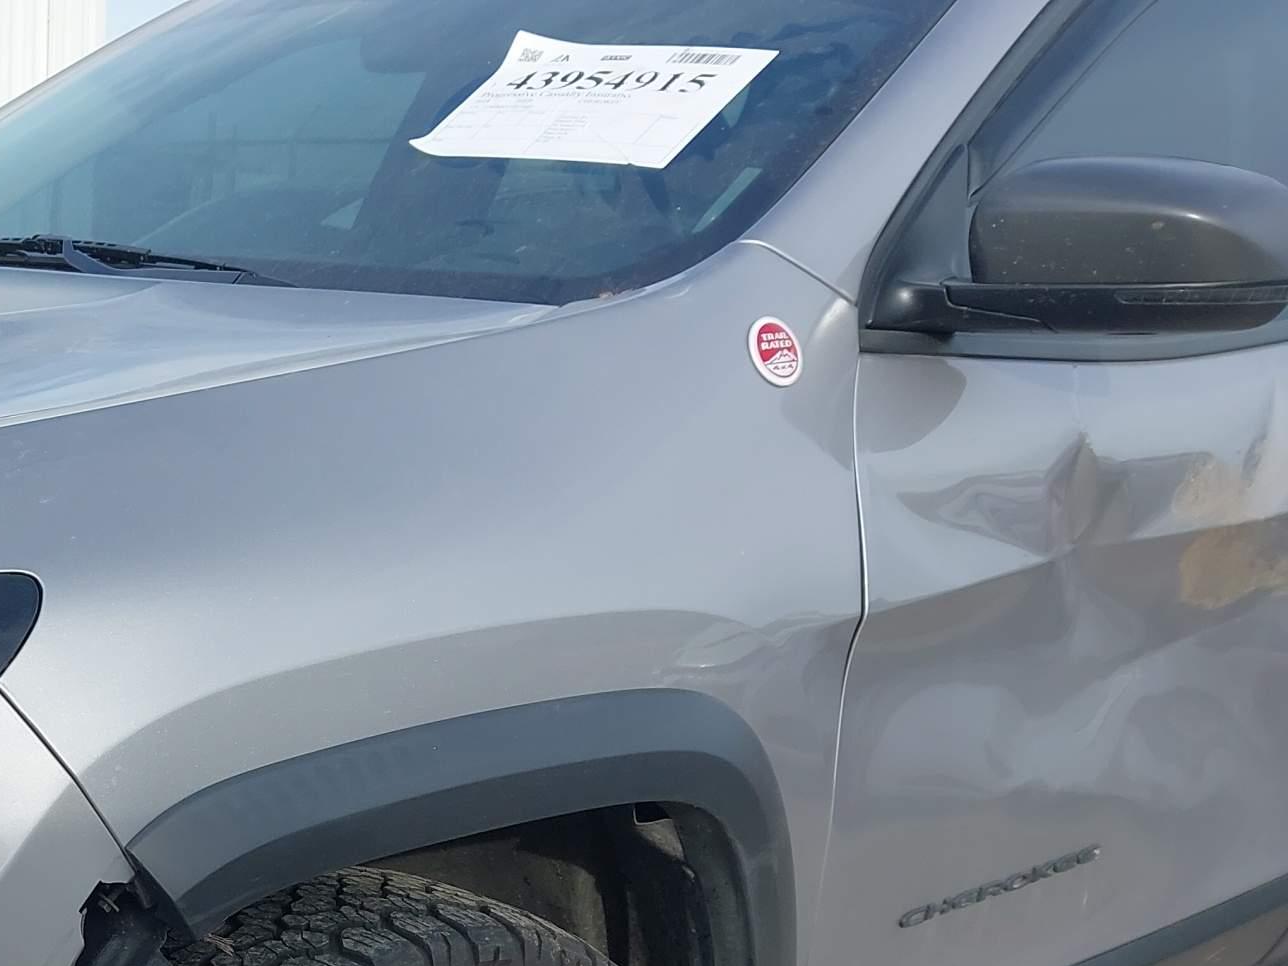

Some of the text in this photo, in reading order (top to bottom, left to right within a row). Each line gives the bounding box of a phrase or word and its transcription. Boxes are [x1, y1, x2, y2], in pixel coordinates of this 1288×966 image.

[506, 70, 717, 93] 43954915
[760, 331, 789, 341] TRAIL
[760, 340, 793, 351] RATED
[898, 843, 1102, 928] CHEROKEE
